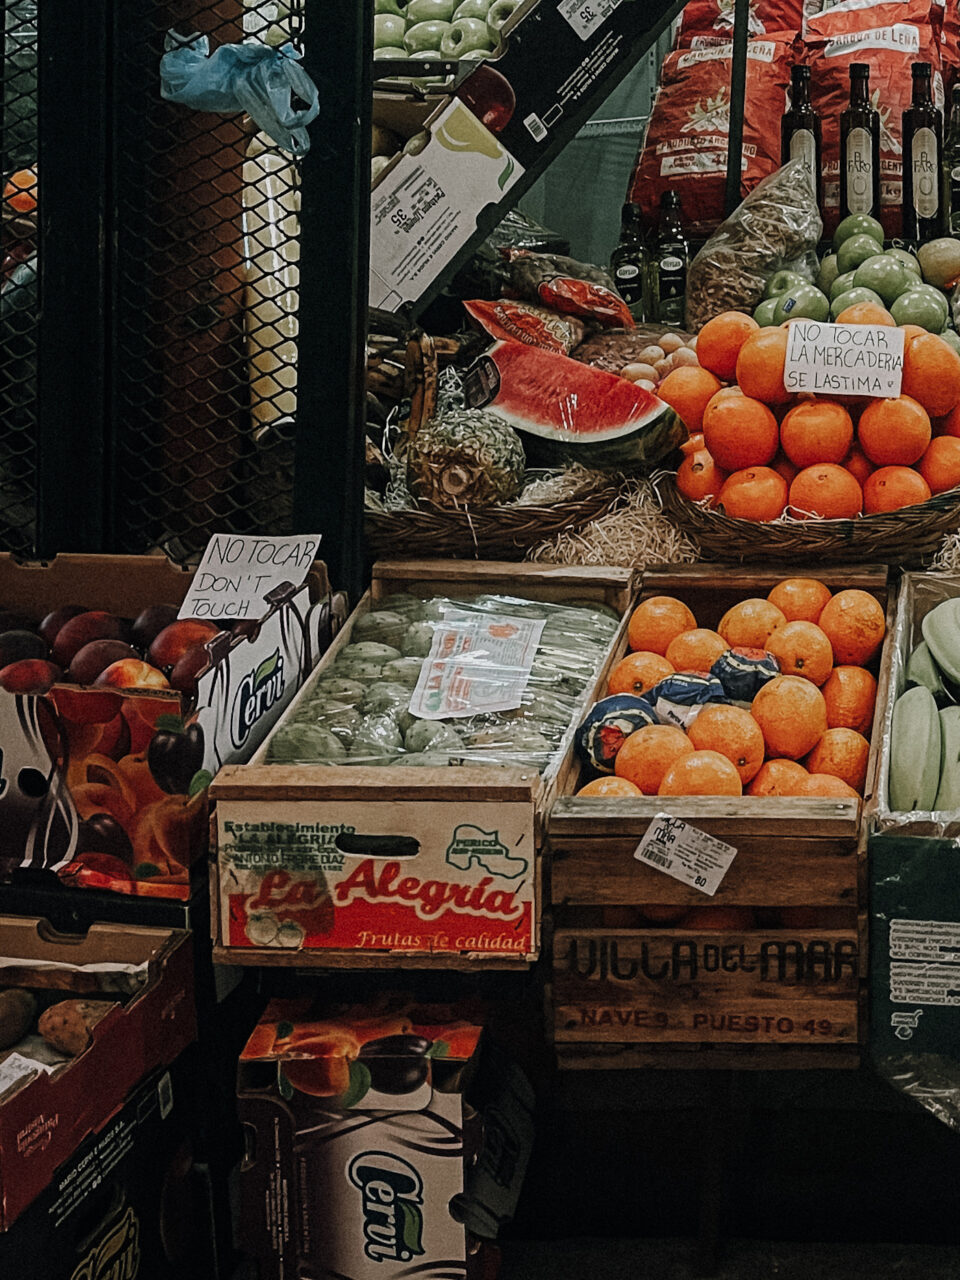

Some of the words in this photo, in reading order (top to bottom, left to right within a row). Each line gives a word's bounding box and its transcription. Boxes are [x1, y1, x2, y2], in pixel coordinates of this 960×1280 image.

[578, 5, 596, 23] 35
[874, 31, 888, 41] DE
[388, 207, 409, 228] 35
[793, 323, 822, 342] NO
[829, 326, 889, 349] TOCAR
[789, 344, 809, 365] LA
[813, 344, 902, 372] MERCADERIA
[787, 370, 808, 388] SE
[814, 372, 882, 393] LASTIMA
[207, 536, 245, 565] NO
[247, 539, 316, 569] TOCAR
[194, 572, 273, 594] DON'T
[191, 598, 250, 618] TOUCH
[231, 655, 285, 750] Cervi
[223, 821, 357, 834] Establecimiento
[249, 869, 318, 911] La
[333, 858, 520, 916] Alegría
[354, 931, 422, 949] Frutas
[453, 931, 531, 951] calidad
[568, 938, 699, 982] VILLA
[702, 943, 757, 975] DEL
[759, 939, 859, 984] MAR
[580, 1007, 652, 1029] NAVE
[692, 1012, 794, 1036] PUESTO
[801, 1018, 834, 1036] 49
[348, 1151, 424, 1263] Cervi
